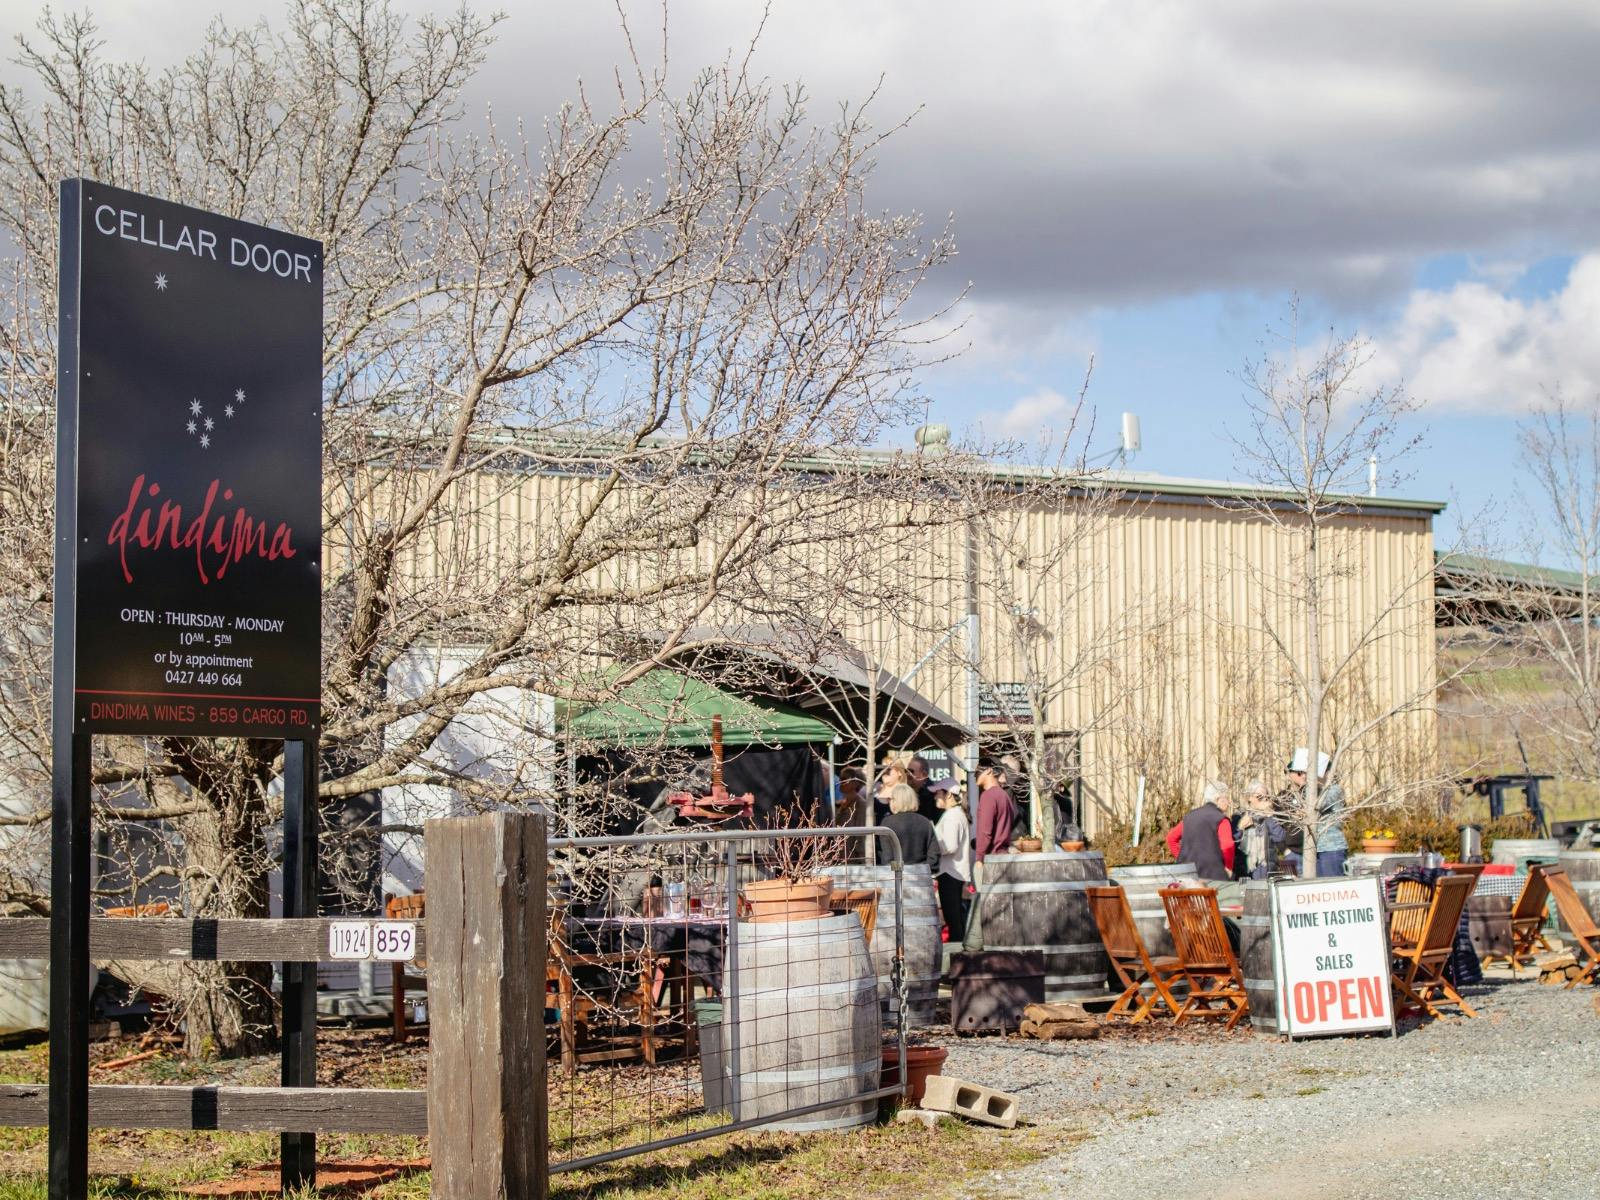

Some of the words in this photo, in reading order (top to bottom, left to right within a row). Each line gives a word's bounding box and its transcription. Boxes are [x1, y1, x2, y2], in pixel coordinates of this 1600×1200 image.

[94, 204, 217, 260] CELLAR
[230, 237, 312, 283] DOOR
[107, 473, 297, 584] dindima
[120, 608, 155, 624] OPEN
[165, 612, 226, 629] THURSDAY
[235, 617, 285, 633] MONDAY
[154, 652, 166, 663] or
[169, 651, 182, 666] by
[185, 653, 253, 668] appointment
[165, 670, 194, 684] 0427
[197, 671, 218, 685] 449
[221, 673, 242, 687] 664
[91, 702, 149, 720] DINDIMA
[153, 704, 195, 722] WINES
[209, 706, 238, 723] 859
[242, 707, 285, 724] CARGO
[1296, 889, 1360, 905] DINDIMA
[1286, 912, 1319, 929] WINE
[1323, 907, 1374, 926] TASTING
[335, 929, 366, 953] 11924
[377, 929, 411, 953] 859
[1327, 932, 1337, 948] &
[1315, 953, 1354, 971] SALES
[1293, 976, 1385, 1025] OPEN
